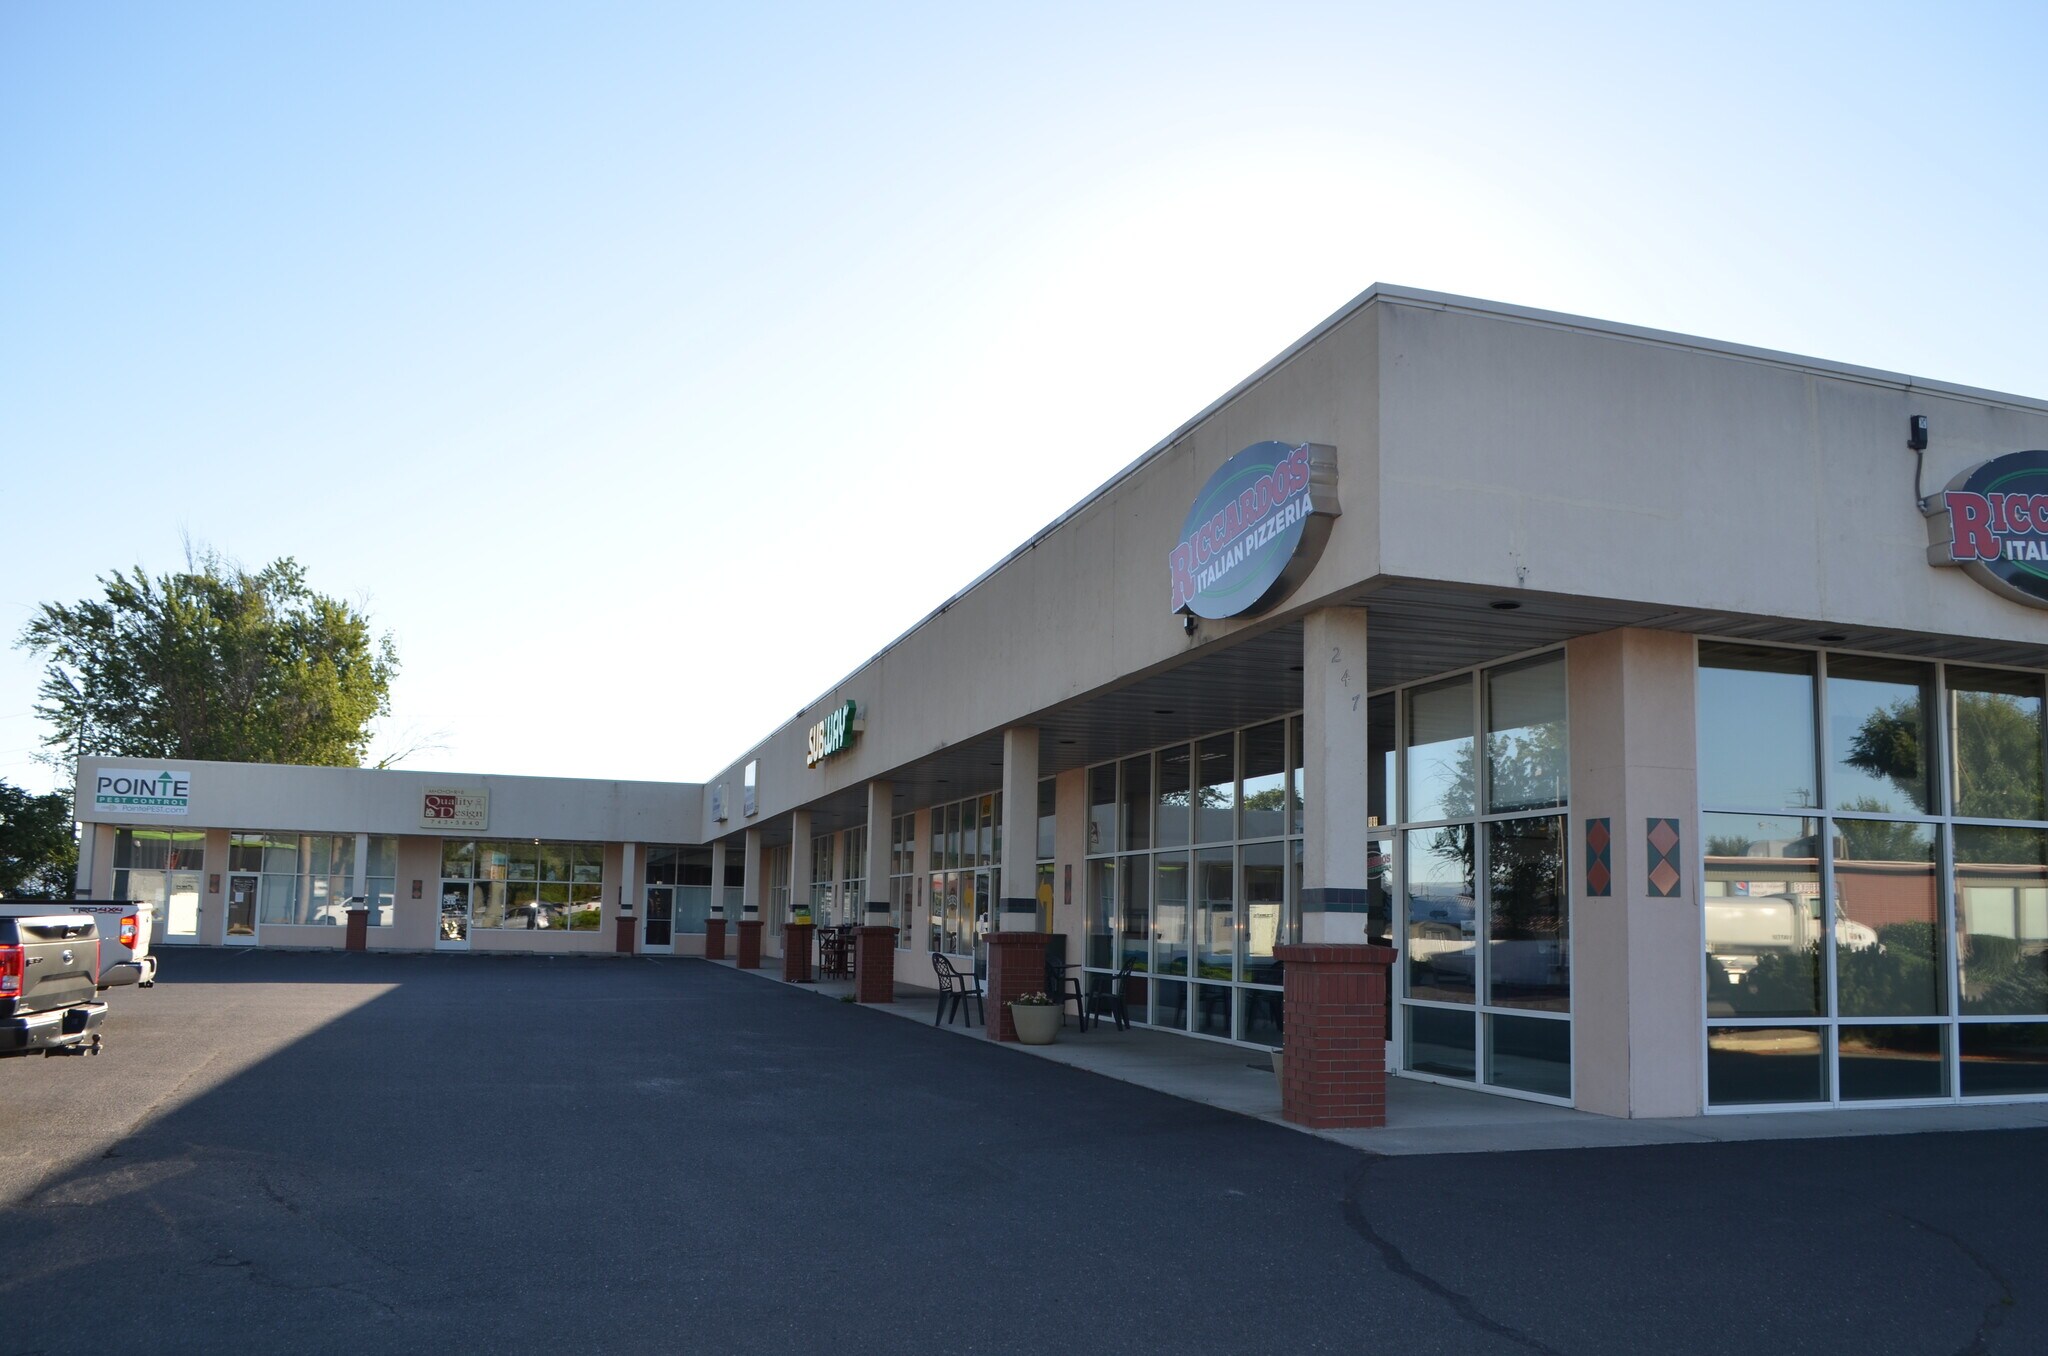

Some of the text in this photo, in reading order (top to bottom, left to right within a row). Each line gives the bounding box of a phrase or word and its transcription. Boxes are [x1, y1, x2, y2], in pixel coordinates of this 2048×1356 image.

[1197, 493, 1314, 594] ITALIAN PIZZERIA
[807, 704, 850, 766] SUBWAY
[97, 776, 189, 797] POINTE
[132, 797, 185, 806] CONTROL
[426, 796, 473, 810] Quality
[440, 806, 483, 819] Design
